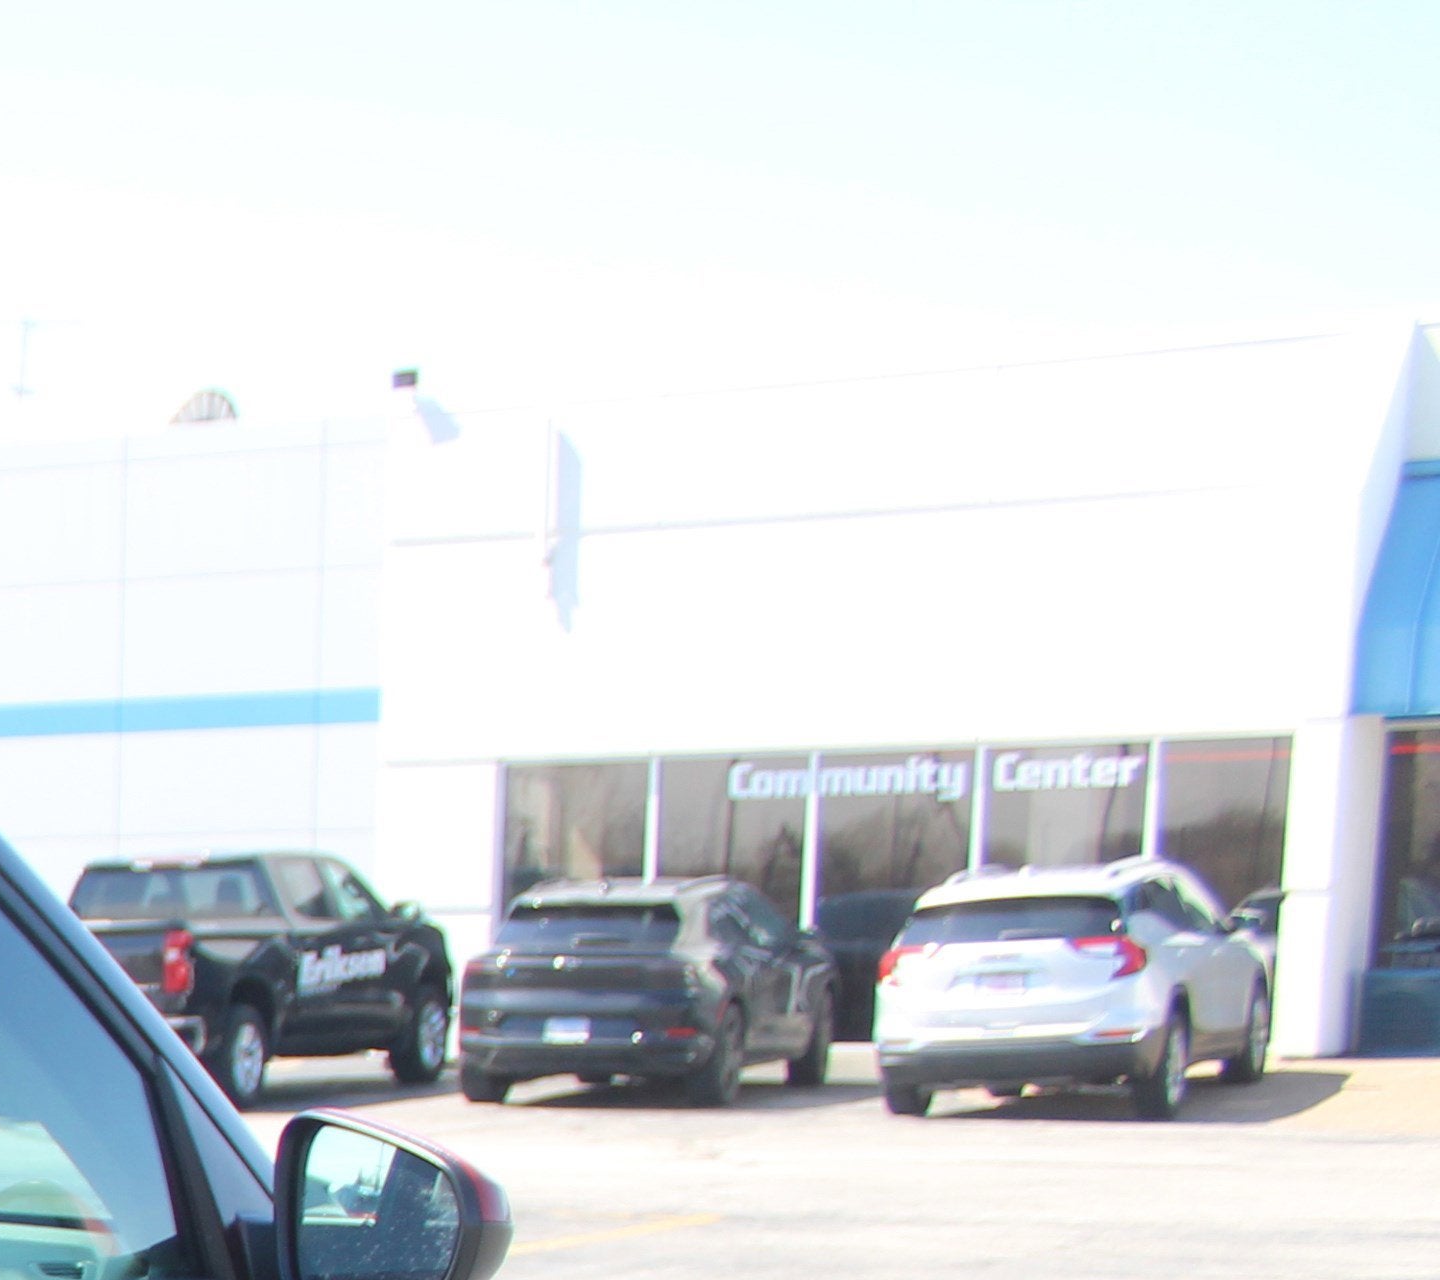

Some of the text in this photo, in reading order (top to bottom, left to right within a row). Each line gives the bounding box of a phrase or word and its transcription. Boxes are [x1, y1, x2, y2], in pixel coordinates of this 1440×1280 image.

[727, 752, 1145, 802] Community Center
[297, 944, 387, 985] Eriksen
